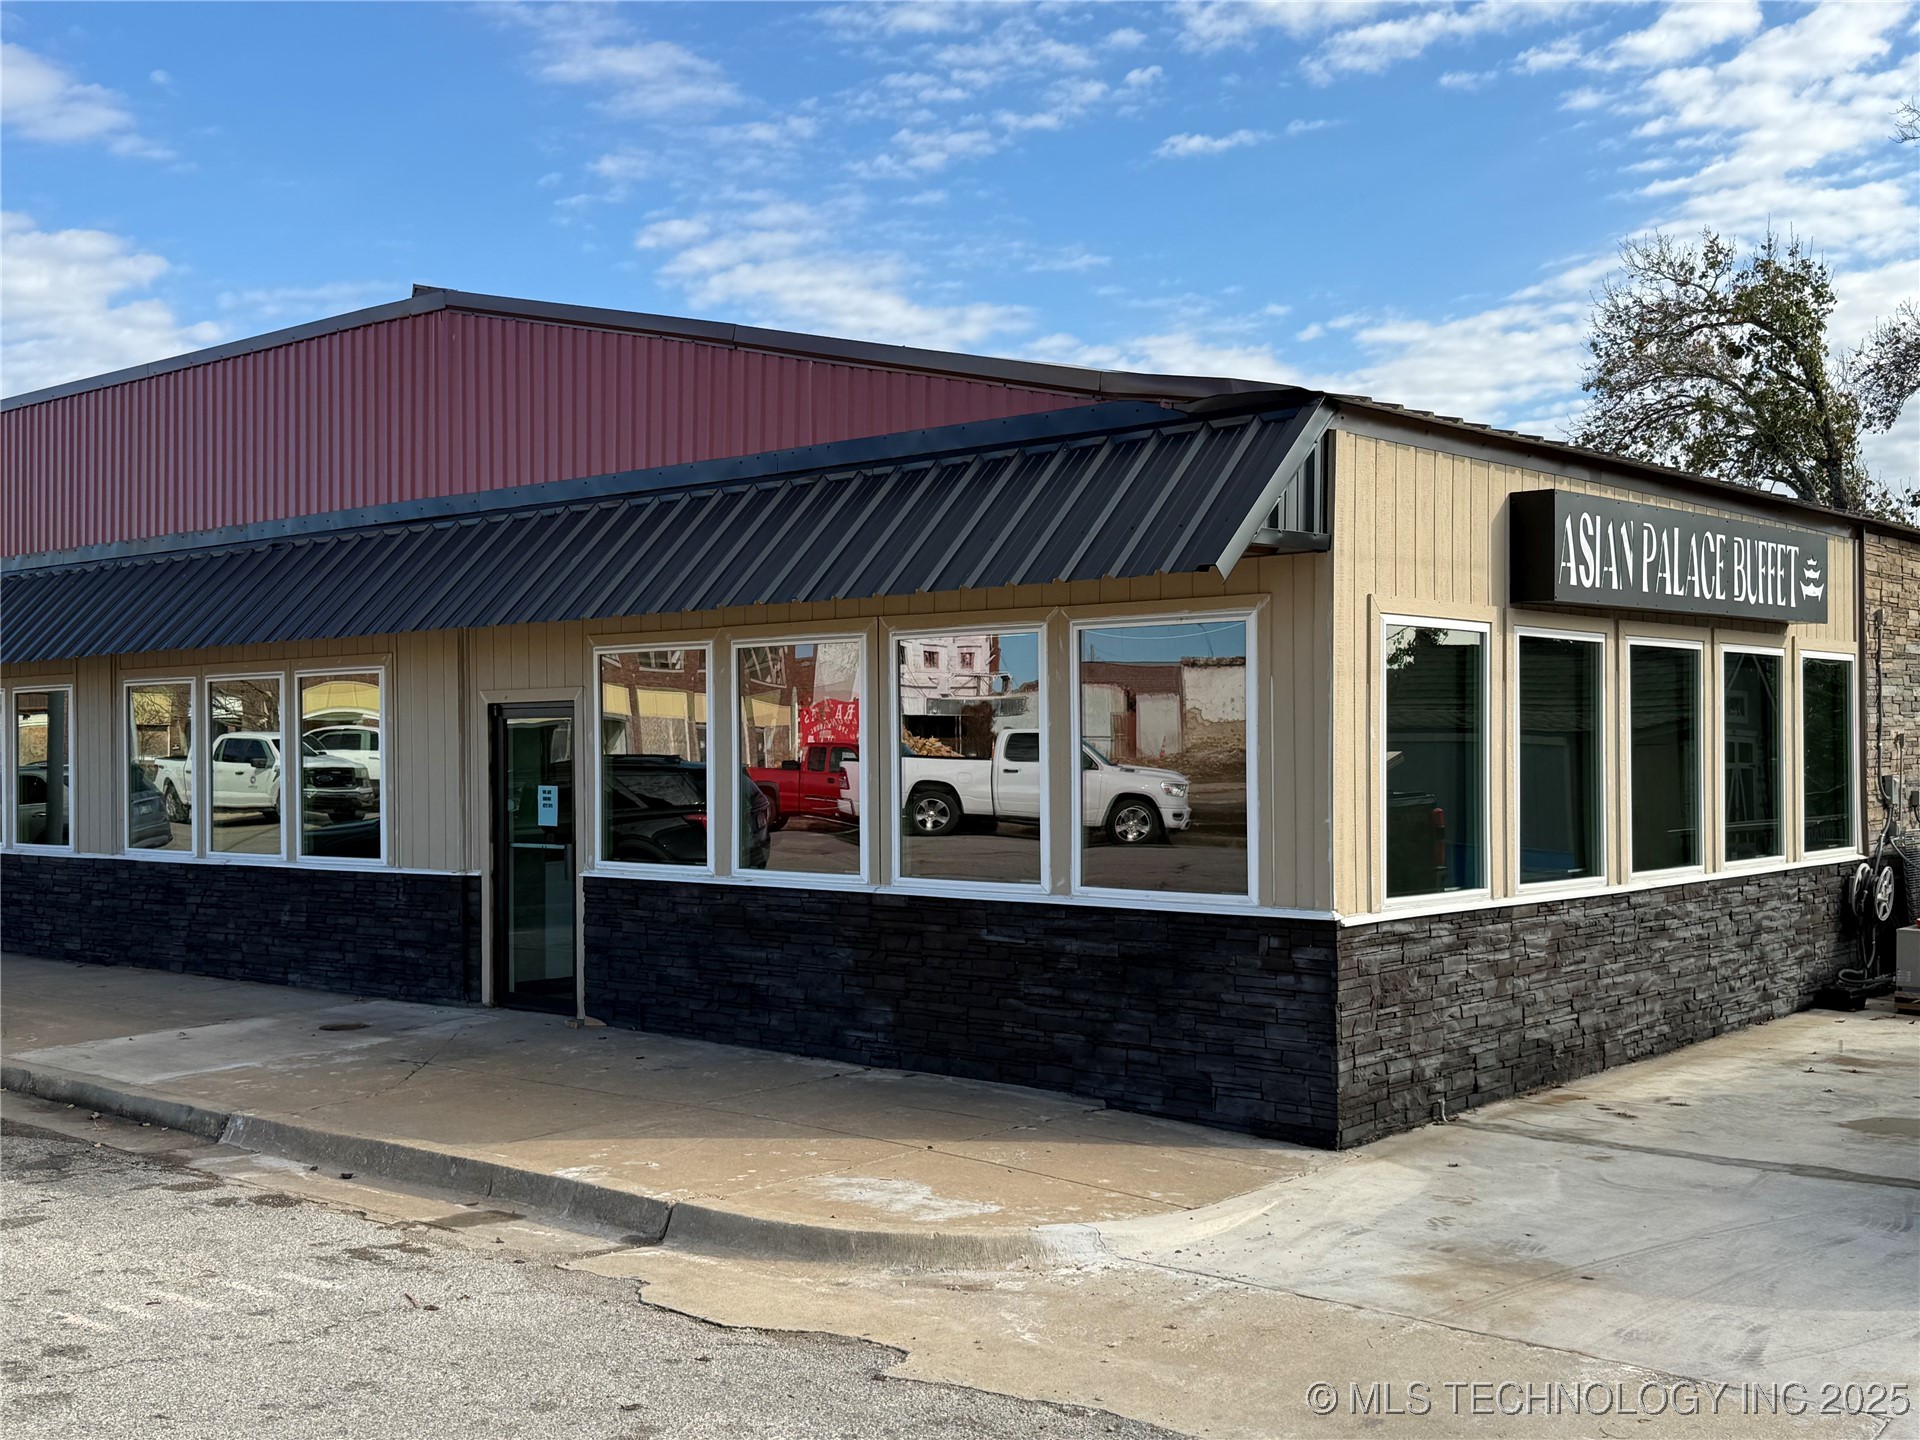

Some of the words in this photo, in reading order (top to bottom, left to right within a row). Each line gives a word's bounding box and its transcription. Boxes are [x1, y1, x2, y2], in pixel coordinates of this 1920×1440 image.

[1558, 511, 1635, 591] ASIAN
[1642, 521, 1727, 601] PALACE
[1733, 536, 1800, 608] BUFFET
